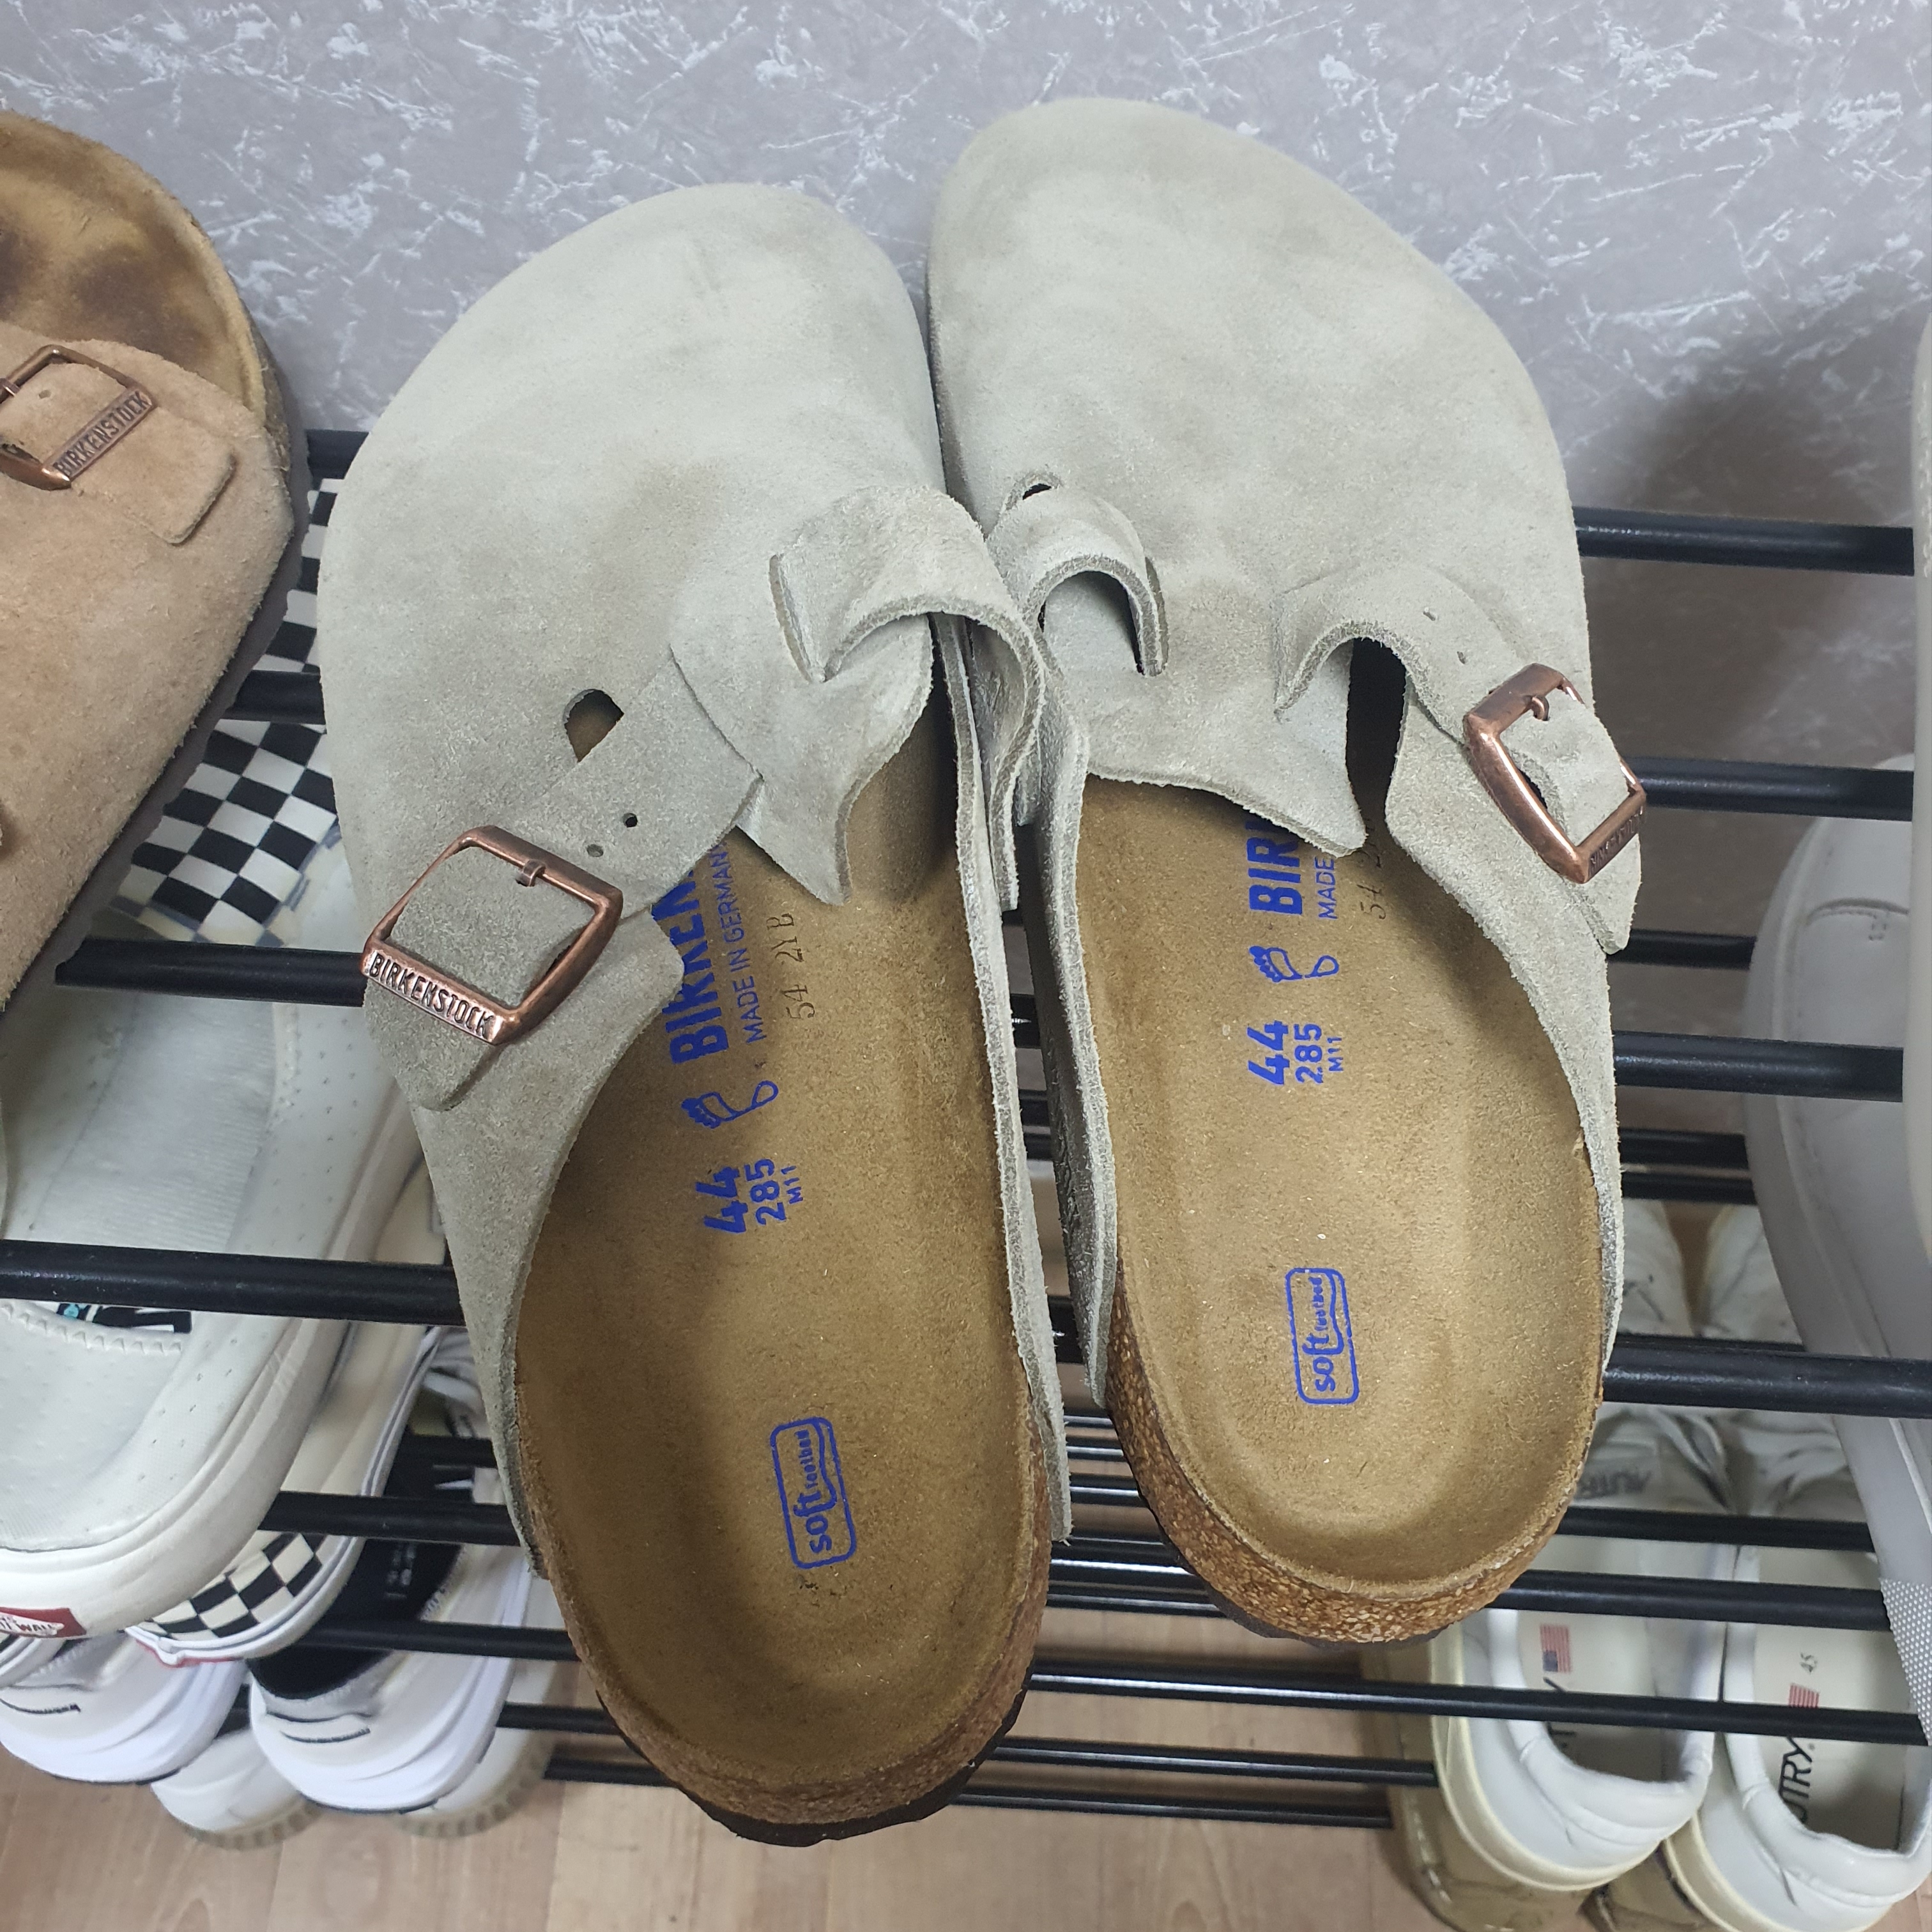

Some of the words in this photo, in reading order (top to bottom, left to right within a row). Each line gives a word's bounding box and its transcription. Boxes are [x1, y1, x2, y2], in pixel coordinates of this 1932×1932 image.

[52, 390, 148, 477] BIRKENSTOCK
[1245, 822, 1302, 915] BIR
[1314, 856, 1338, 919] MADE
[651, 871, 729, 1064] BIRKEN
[726, 948, 750, 972] IN
[369, 953, 495, 1039] BIRKENSTOCK
[733, 976, 767, 1043] MADE
[1247, 1020, 1290, 1085] 44
[1294, 1023, 1323, 1084] 285
[1327, 1036, 1344, 1072] M11
[695, 1167, 748, 1234] 44
[744, 1159, 786, 1225] 285
[781, 1165, 803, 1204] M11
